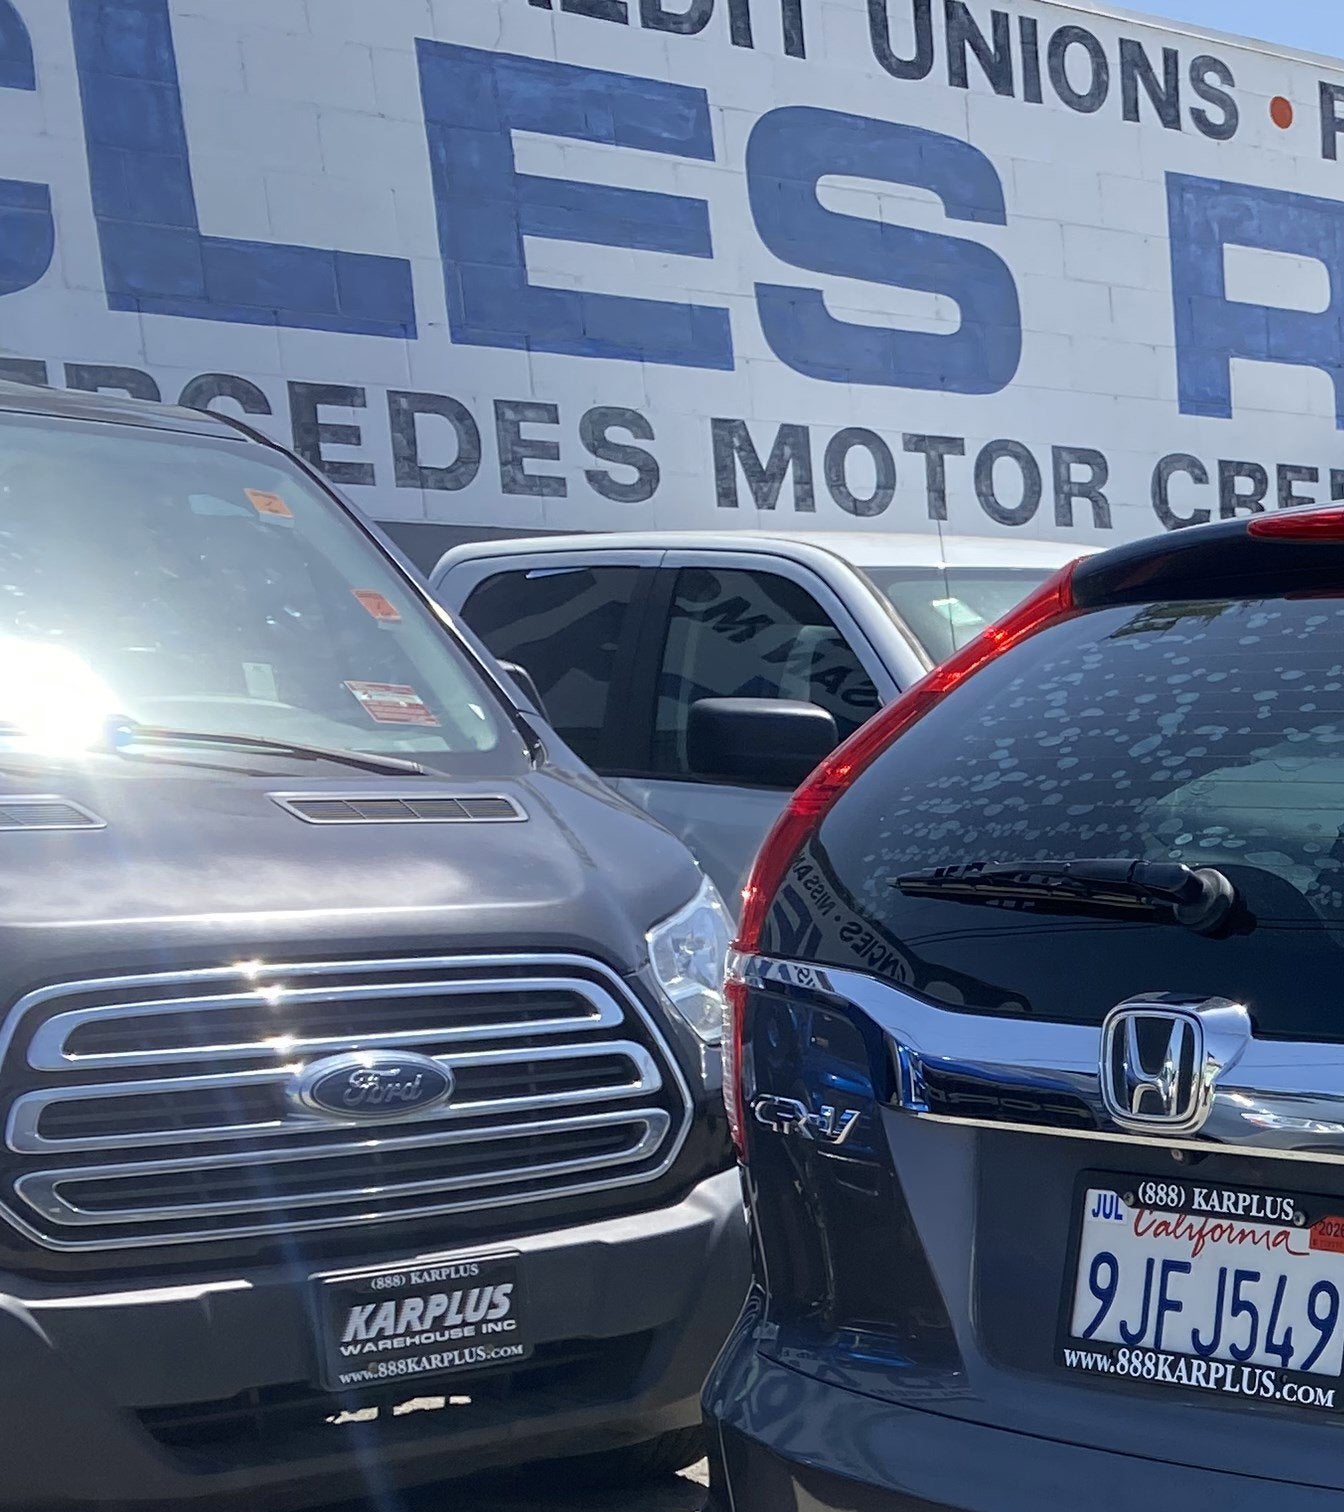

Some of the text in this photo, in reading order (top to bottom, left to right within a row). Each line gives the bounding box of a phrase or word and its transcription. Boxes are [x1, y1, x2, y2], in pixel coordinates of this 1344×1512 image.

[868, 0, 1240, 141] UNIONS
[0, 0, 1022, 395] LES
[710, 417, 1113, 529] MOTOR
[342, 1067, 423, 1107] Ford
[1091, 1193, 1124, 1222] JUL
[1137, 1181, 1295, 1221] (888) KARPLUS
[1133, 1208, 1310, 1259] California
[370, 1263, 480, 1291] (888) KARPLUS
[341, 1282, 514, 1343] KARPLUS
[1081, 1251, 1340, 1371] 9JFJ549
[339, 1319, 518, 1357] WAREHOUSE INC
